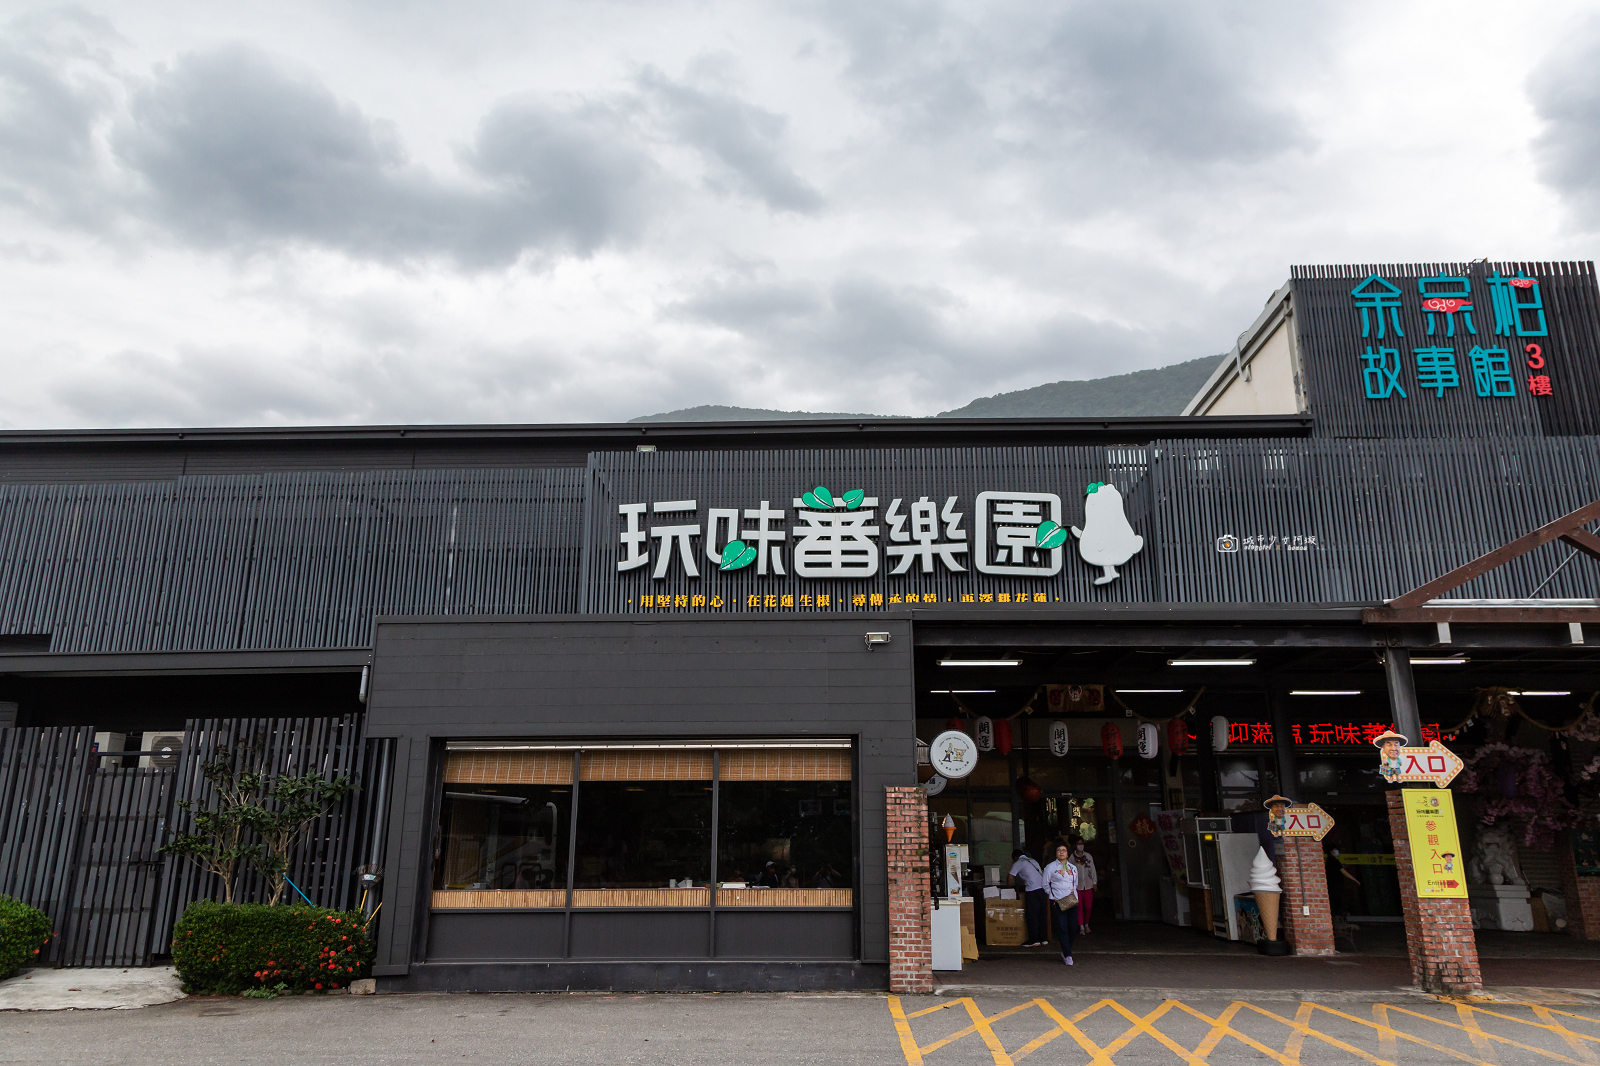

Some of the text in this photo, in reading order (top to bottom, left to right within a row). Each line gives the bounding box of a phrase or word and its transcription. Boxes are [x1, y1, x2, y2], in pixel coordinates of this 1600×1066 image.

[1351, 271, 1548, 339] 余宗柏
[1361, 344, 1516, 398] 故事館
[1405, 755, 1447, 775] 入口
[1288, 813, 1322, 830] 入口
